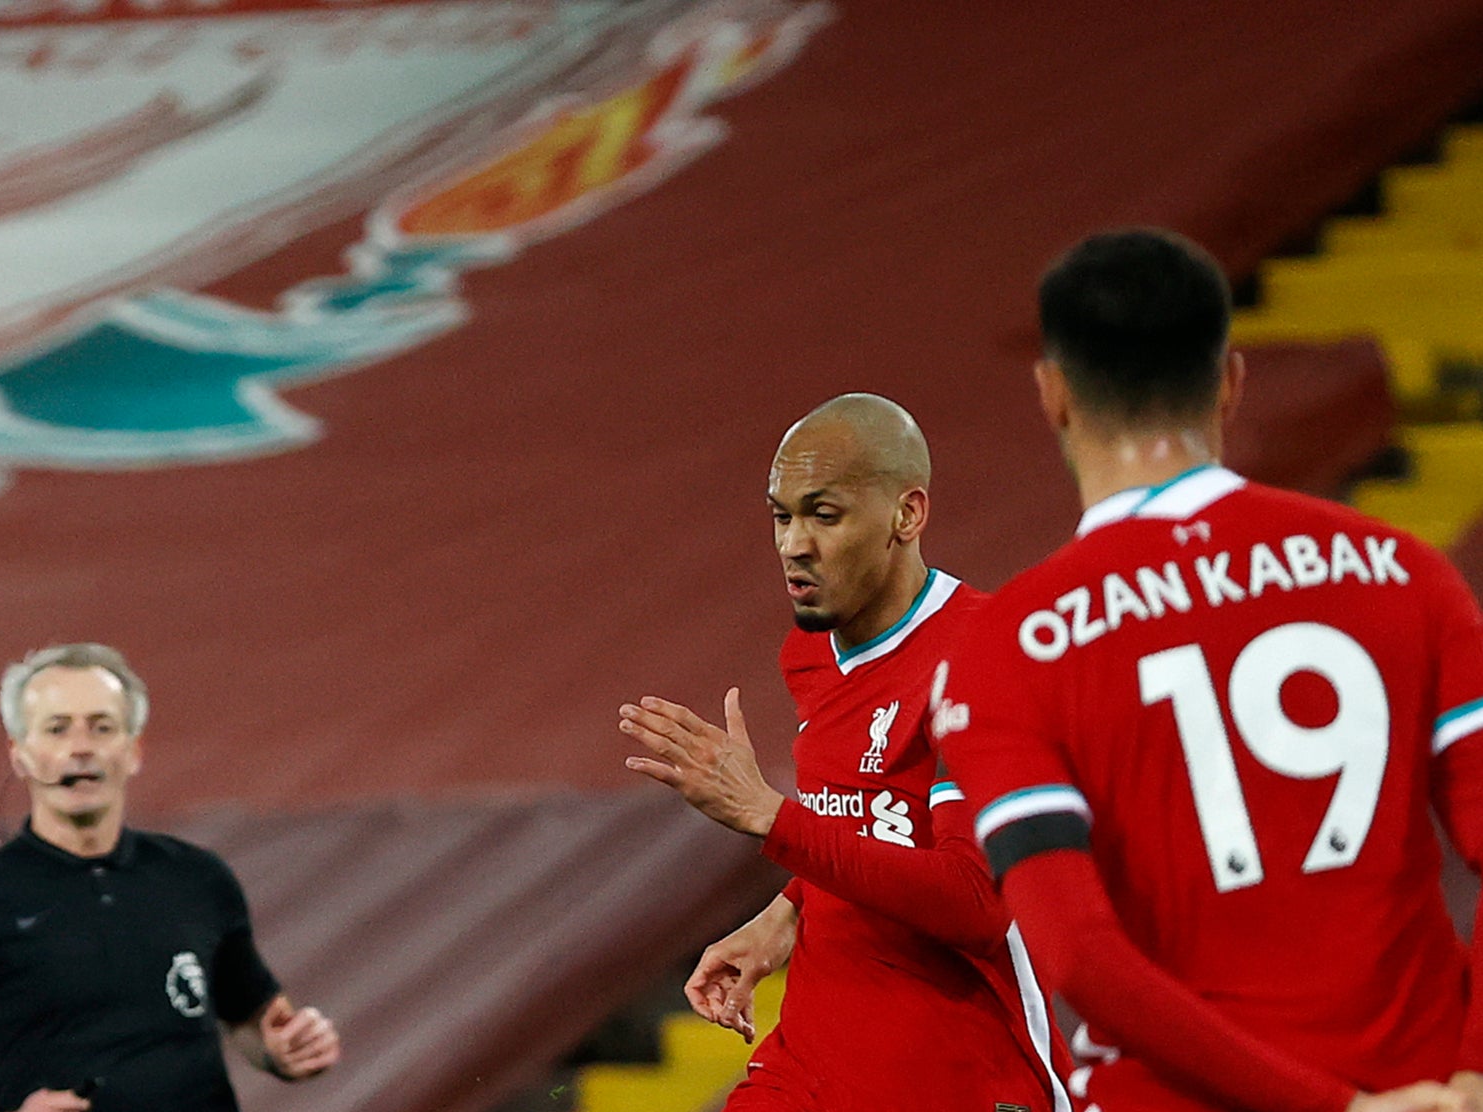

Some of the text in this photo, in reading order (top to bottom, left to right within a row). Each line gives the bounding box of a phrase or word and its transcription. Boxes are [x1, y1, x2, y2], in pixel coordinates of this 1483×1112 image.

[1018, 532, 1410, 663] OZAN KABAK
[796, 785, 865, 819] tandard
[1137, 620, 1391, 893] 19
